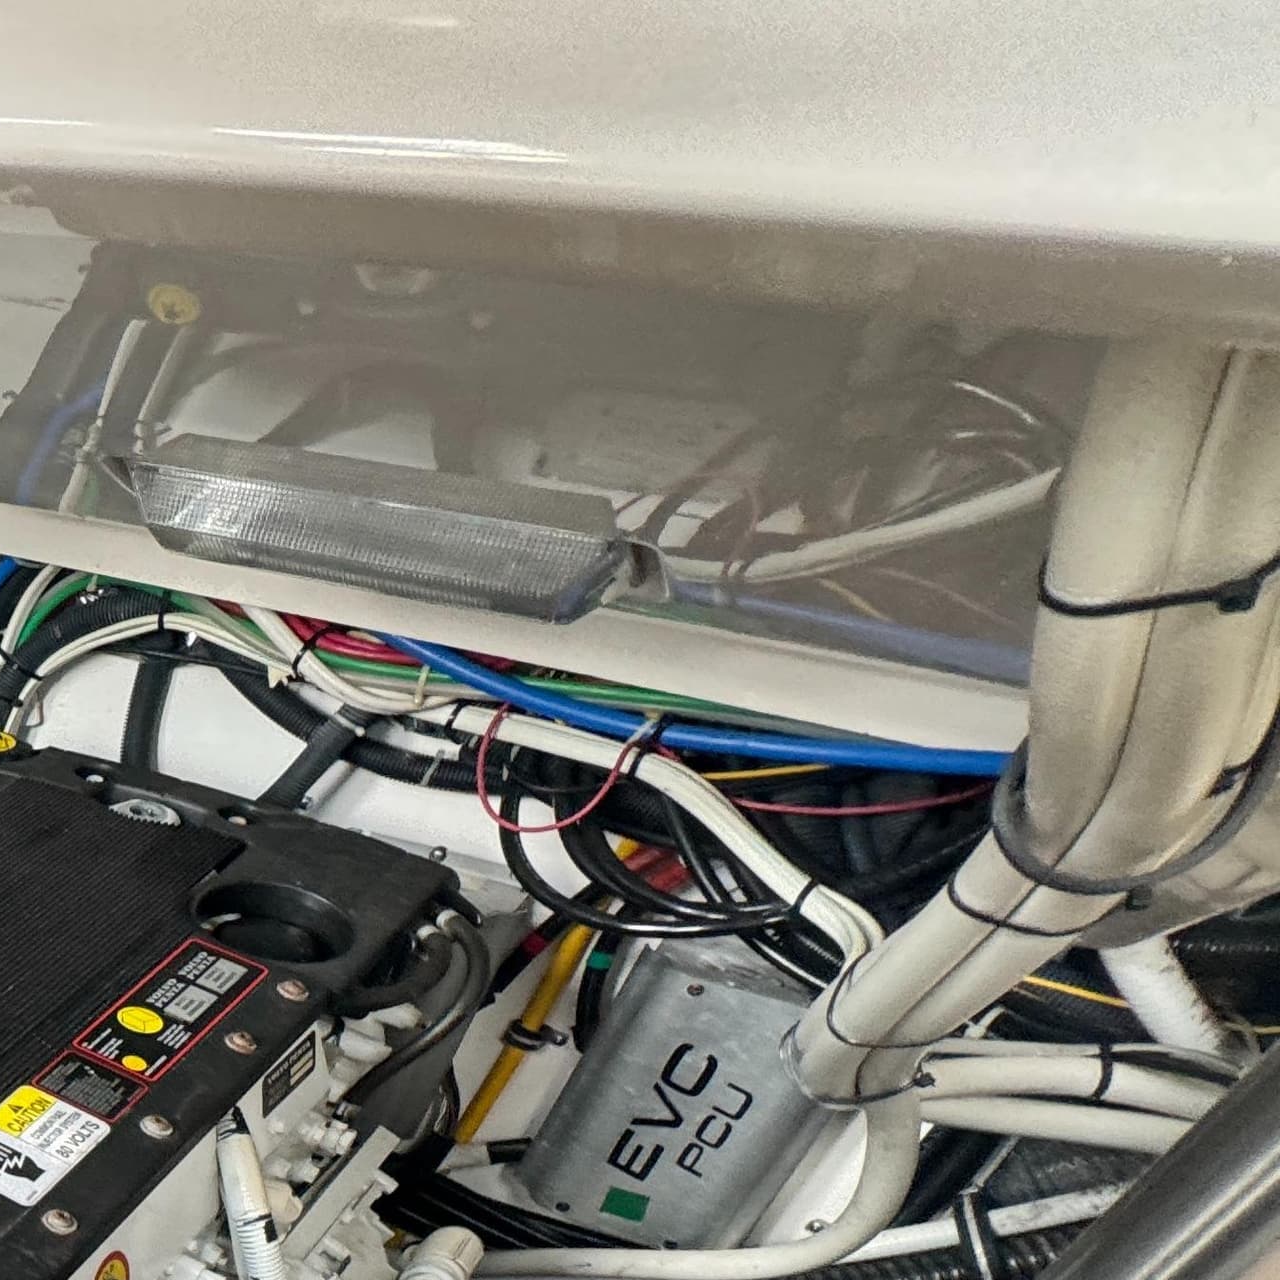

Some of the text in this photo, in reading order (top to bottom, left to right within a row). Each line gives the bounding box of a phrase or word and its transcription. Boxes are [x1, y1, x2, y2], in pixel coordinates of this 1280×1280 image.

[6, 1096, 52, 1133] CAUTION
[64, 1120, 100, 1147] VOLTS
[607, 1043, 718, 1182] EVC
[676, 1082, 754, 1178] PCU
